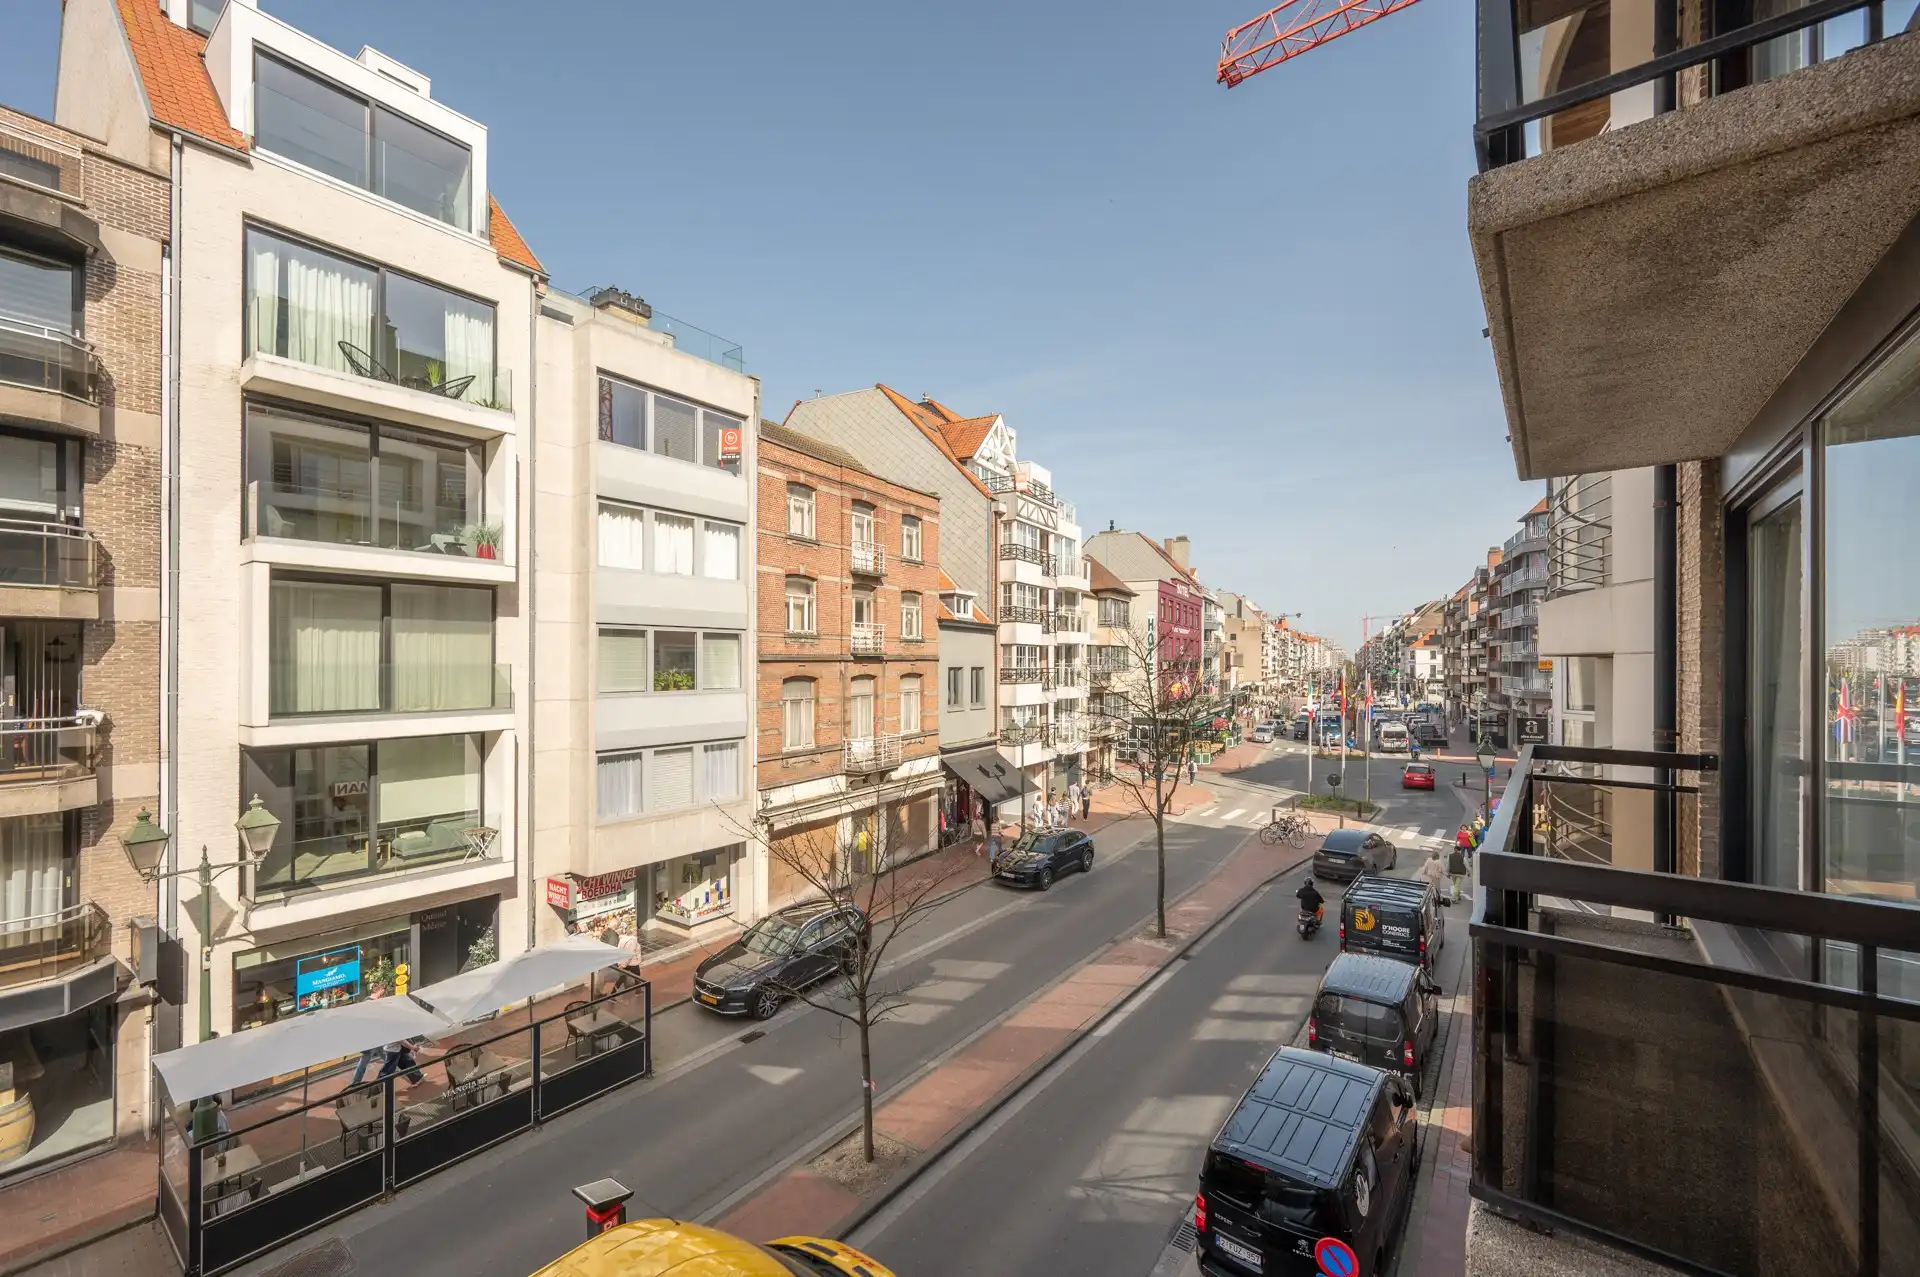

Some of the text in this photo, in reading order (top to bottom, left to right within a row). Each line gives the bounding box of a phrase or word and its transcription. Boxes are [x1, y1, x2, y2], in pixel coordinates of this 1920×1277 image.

[577, 868, 637, 892] ACHTWINKEL
[549, 882, 567, 895] NACHT
[581, 881, 622, 900] BOEDDHA
[1382, 924, 1410, 934] D'HOORE
